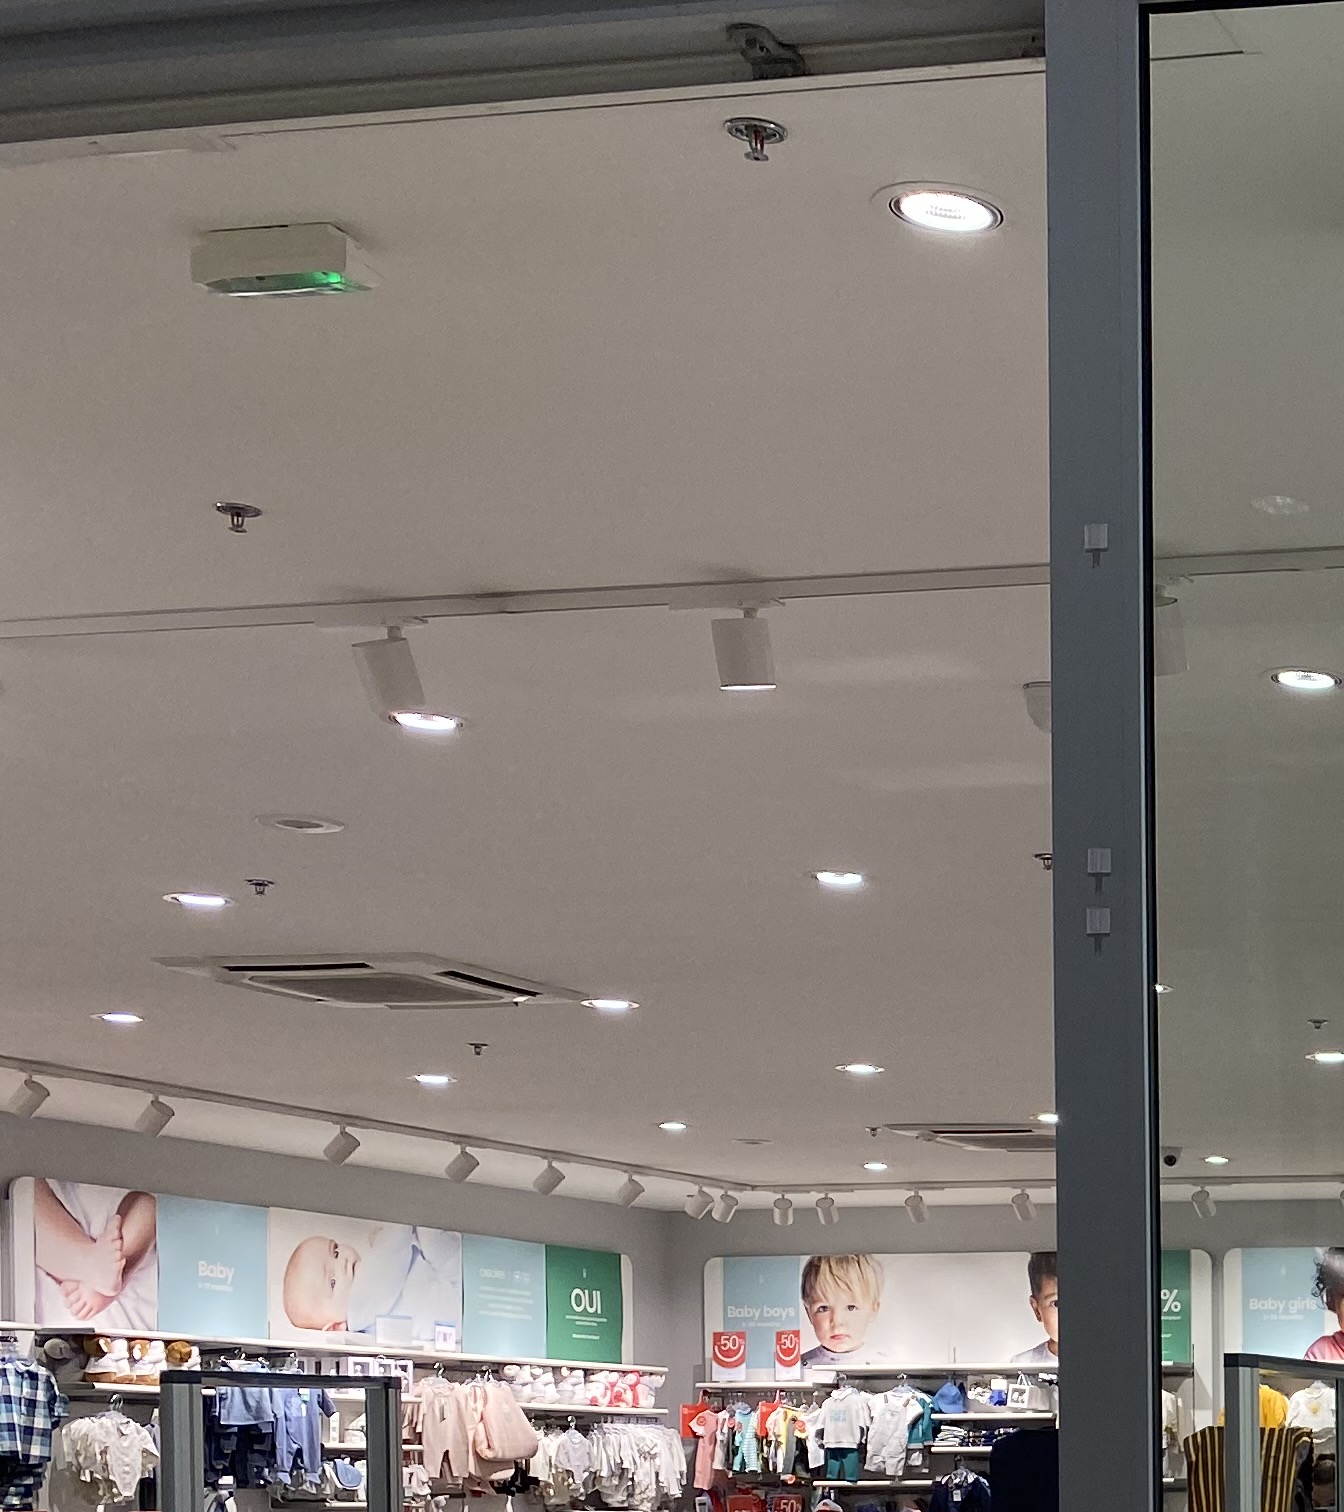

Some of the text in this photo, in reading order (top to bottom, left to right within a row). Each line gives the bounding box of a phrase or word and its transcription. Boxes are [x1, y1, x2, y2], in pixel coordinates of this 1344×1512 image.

[198, 1260, 234, 1284] Baby
[571, 1288, 602, 1314] OUI
[1249, 1297, 1316, 1313] Baby girls
[727, 1304, 795, 1320] Baby boys
